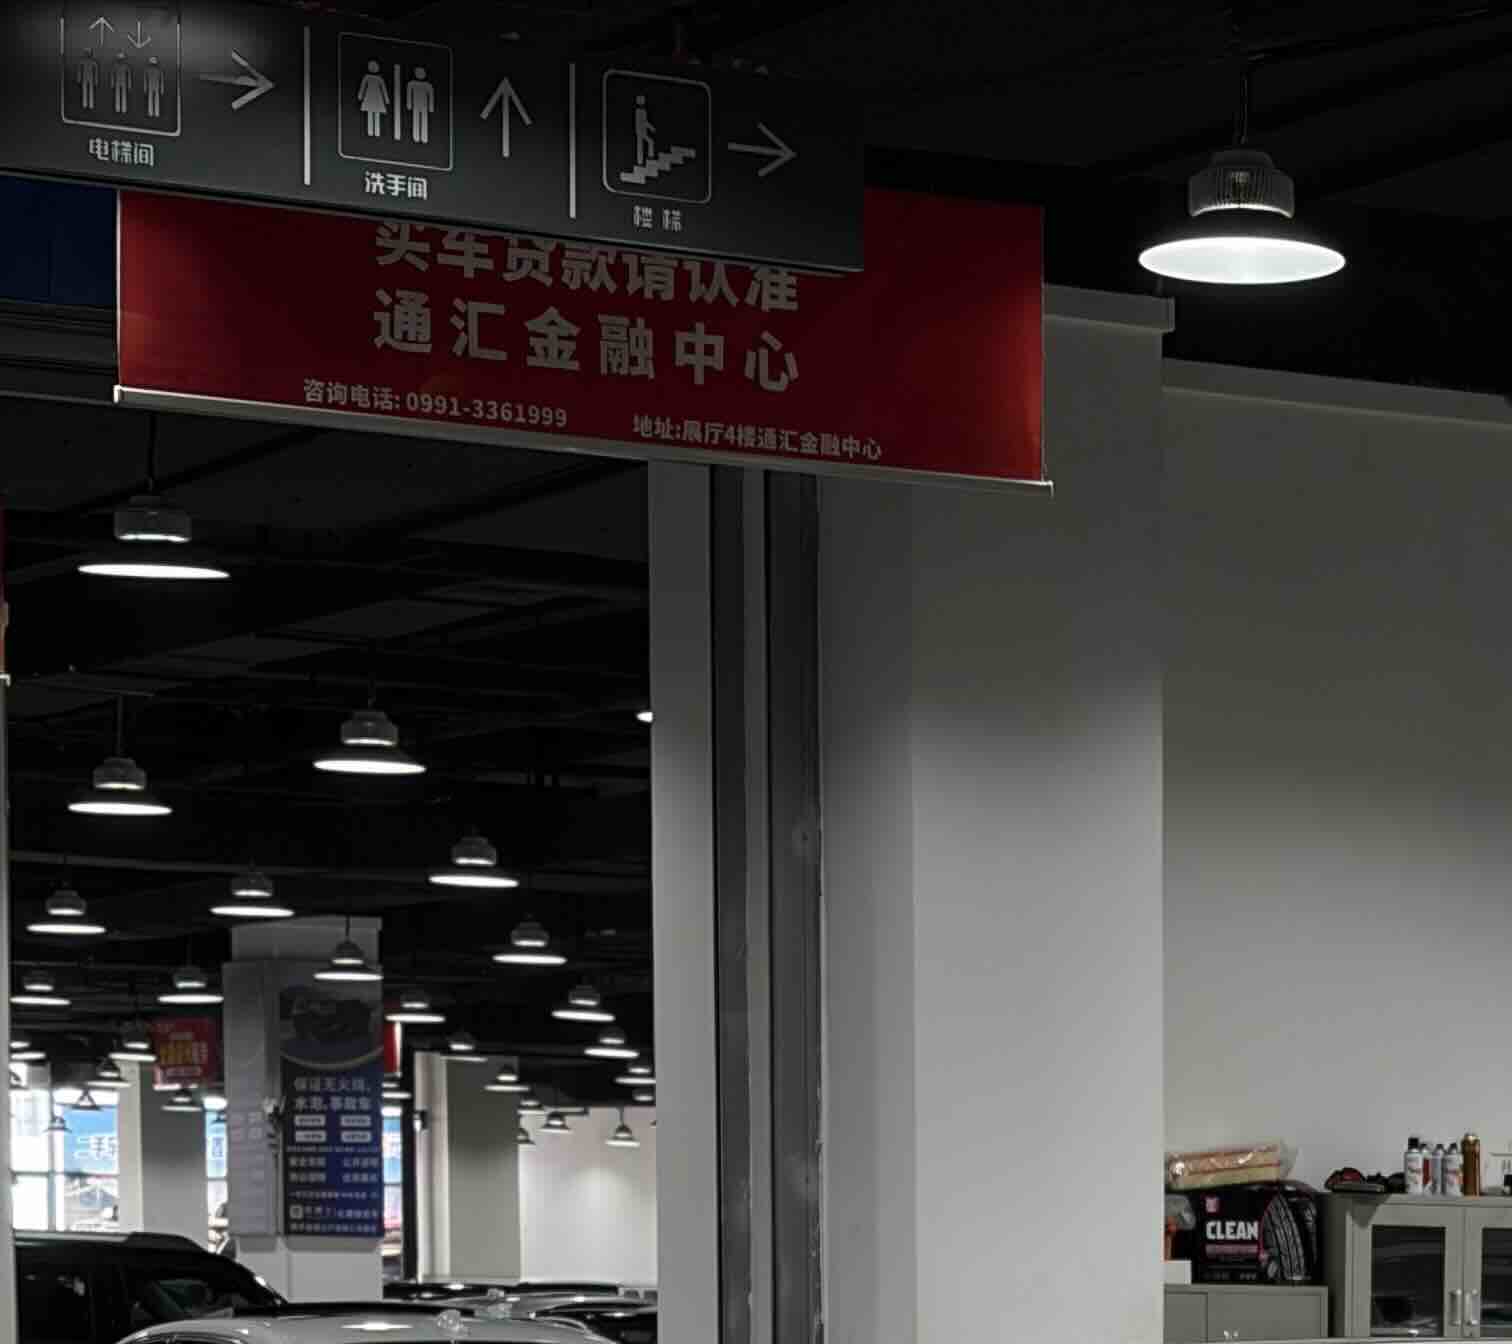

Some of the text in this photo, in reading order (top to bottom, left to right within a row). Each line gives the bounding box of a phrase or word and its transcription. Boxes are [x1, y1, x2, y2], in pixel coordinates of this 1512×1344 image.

[88, 138, 154, 167] 电梯间
[364, 170, 428, 200] 洗手间
[373, 288, 799, 392] 通汇金融中心
[406, 391, 568, 428] 0991-3361999
[1205, 1220, 1259, 1240] CLEAN
